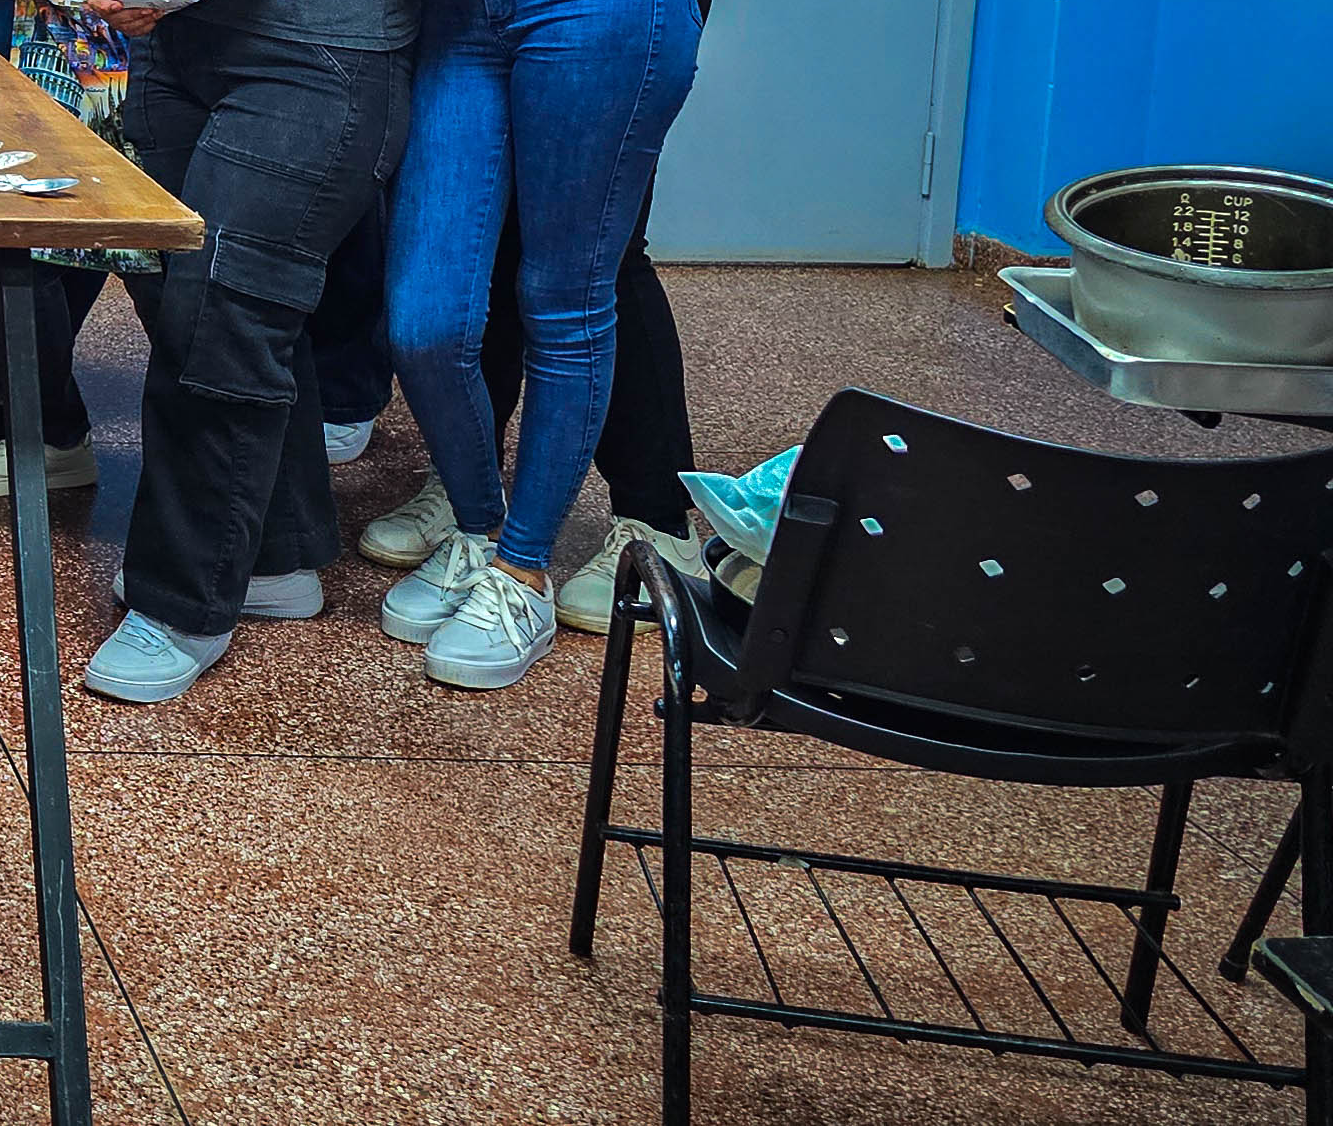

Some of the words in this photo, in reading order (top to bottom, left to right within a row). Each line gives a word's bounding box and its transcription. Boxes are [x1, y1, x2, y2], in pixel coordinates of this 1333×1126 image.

[1223, 195, 1253, 207] CUP
[1234, 210, 1251, 221] 12
[1233, 224, 1249, 235] 10
[1233, 239, 1244, 249] 8
[1232, 253, 1242, 264] 6
